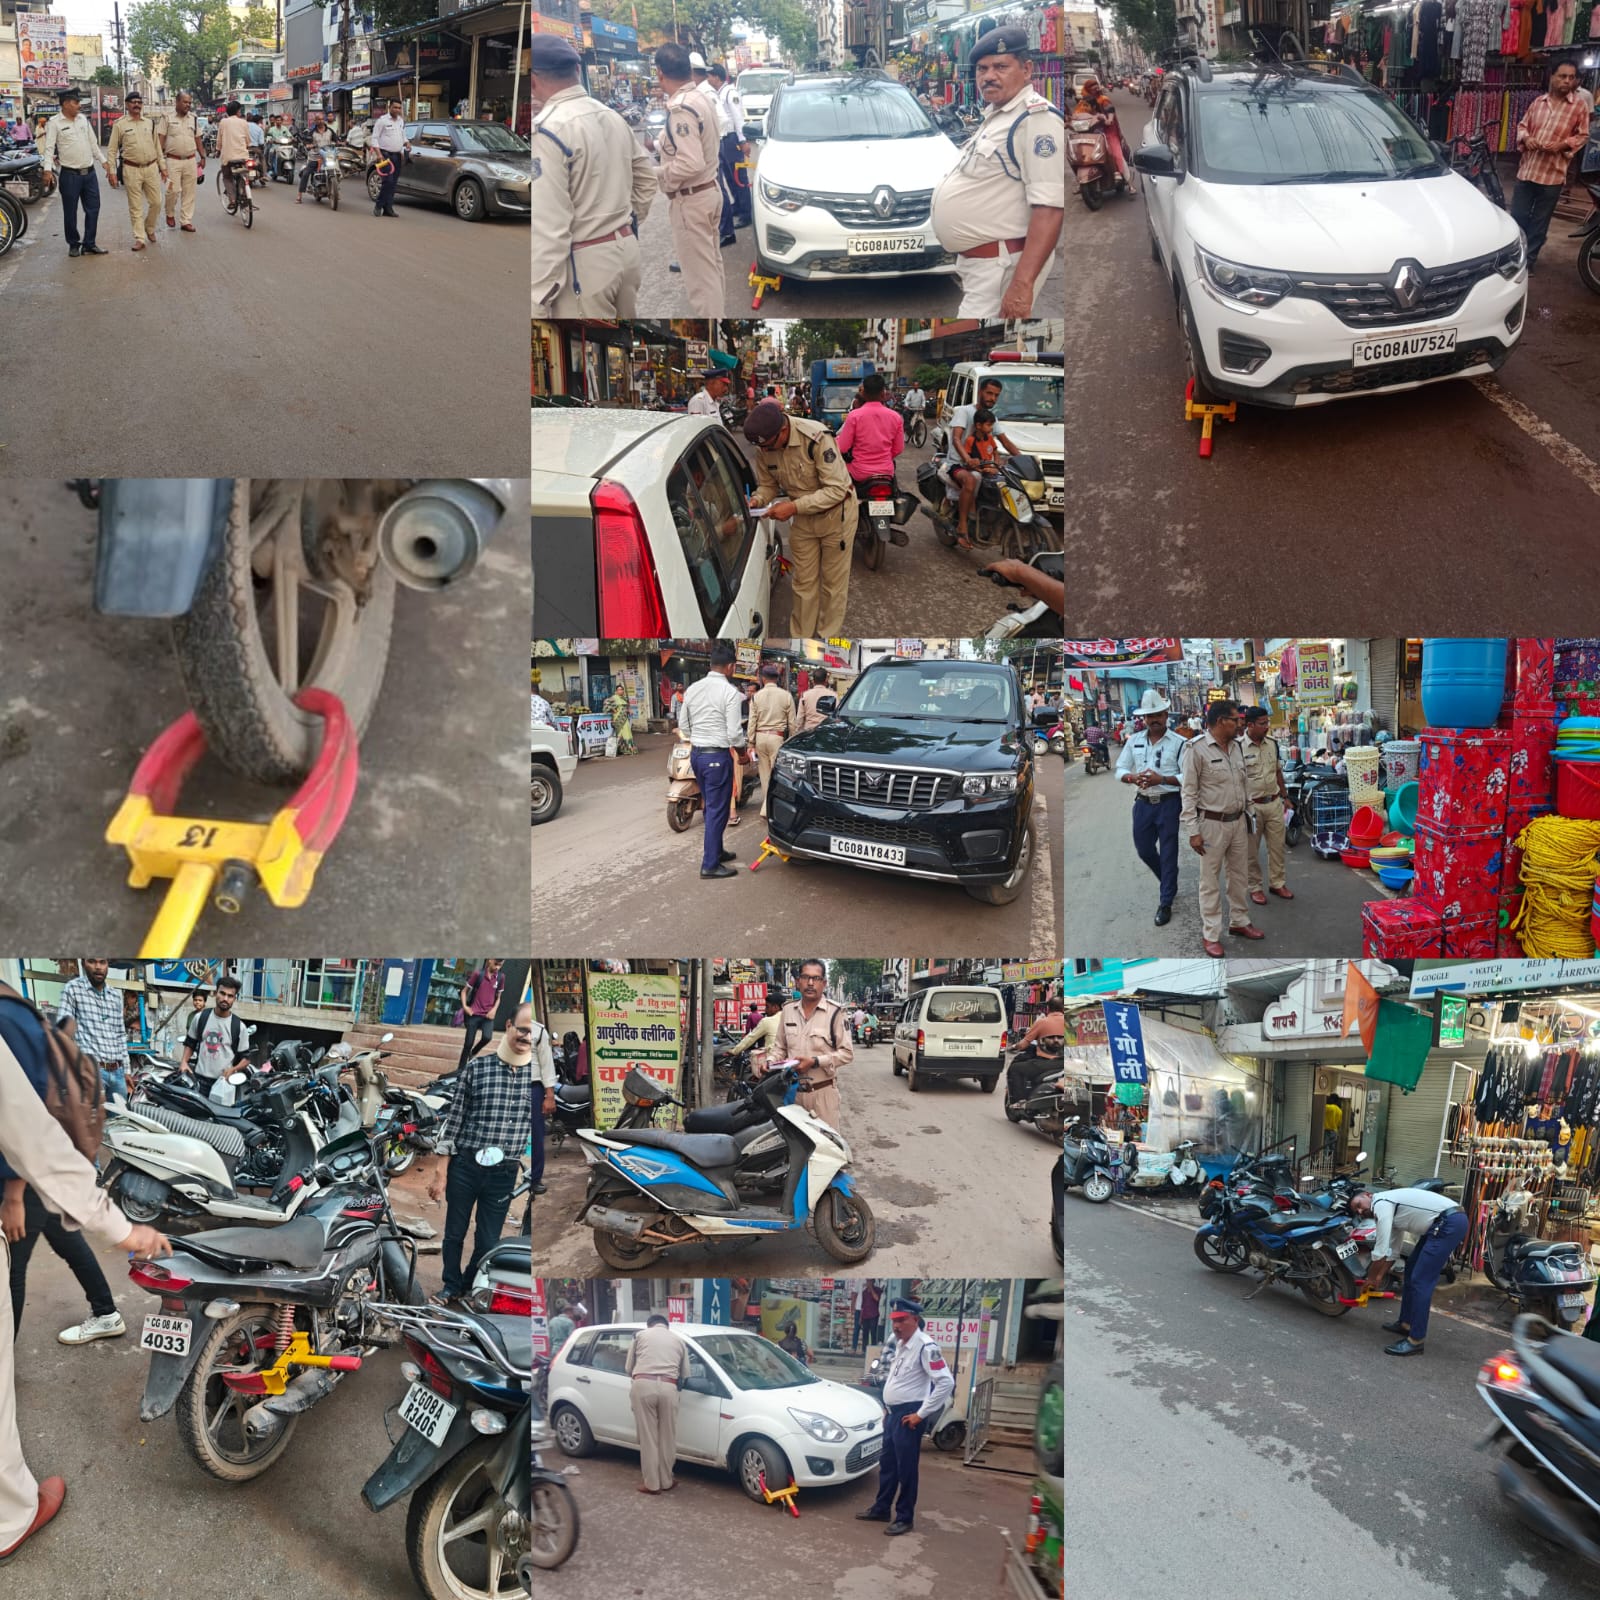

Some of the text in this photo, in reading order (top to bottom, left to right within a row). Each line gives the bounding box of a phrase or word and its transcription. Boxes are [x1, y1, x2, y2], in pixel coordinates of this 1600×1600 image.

[855, 238, 923, 252] CG08AU7524
[1364, 333, 1455, 361] CG08AU7524
[1302, 657, 1329, 673] लगेज
[1303, 676, 1330, 690] कॉर्नर
[838, 840, 904, 862] CG08AY8433
[1526, 958, 1548, 969] BELT
[1421, 964, 1503, 982] GOGGLE WATCH
[1524, 973, 1542, 983] CAP
[743, 985, 763, 999] NN
[719, 1000, 735, 1012] NN
[1272, 1011, 1297, 1031] गायत्री
[596, 1022, 676, 1045] आयुर्वेदिक क्लीनिक
[668, 1301, 683, 1315] NN
[151, 1318, 182, 1331] CG 08 AK
[926, 1321, 978, 1334] ELCOM
[144, 1333, 185, 1353] 4033
[413, 1387, 445, 1421] CG08A
[403, 1402, 437, 1437] R3406
